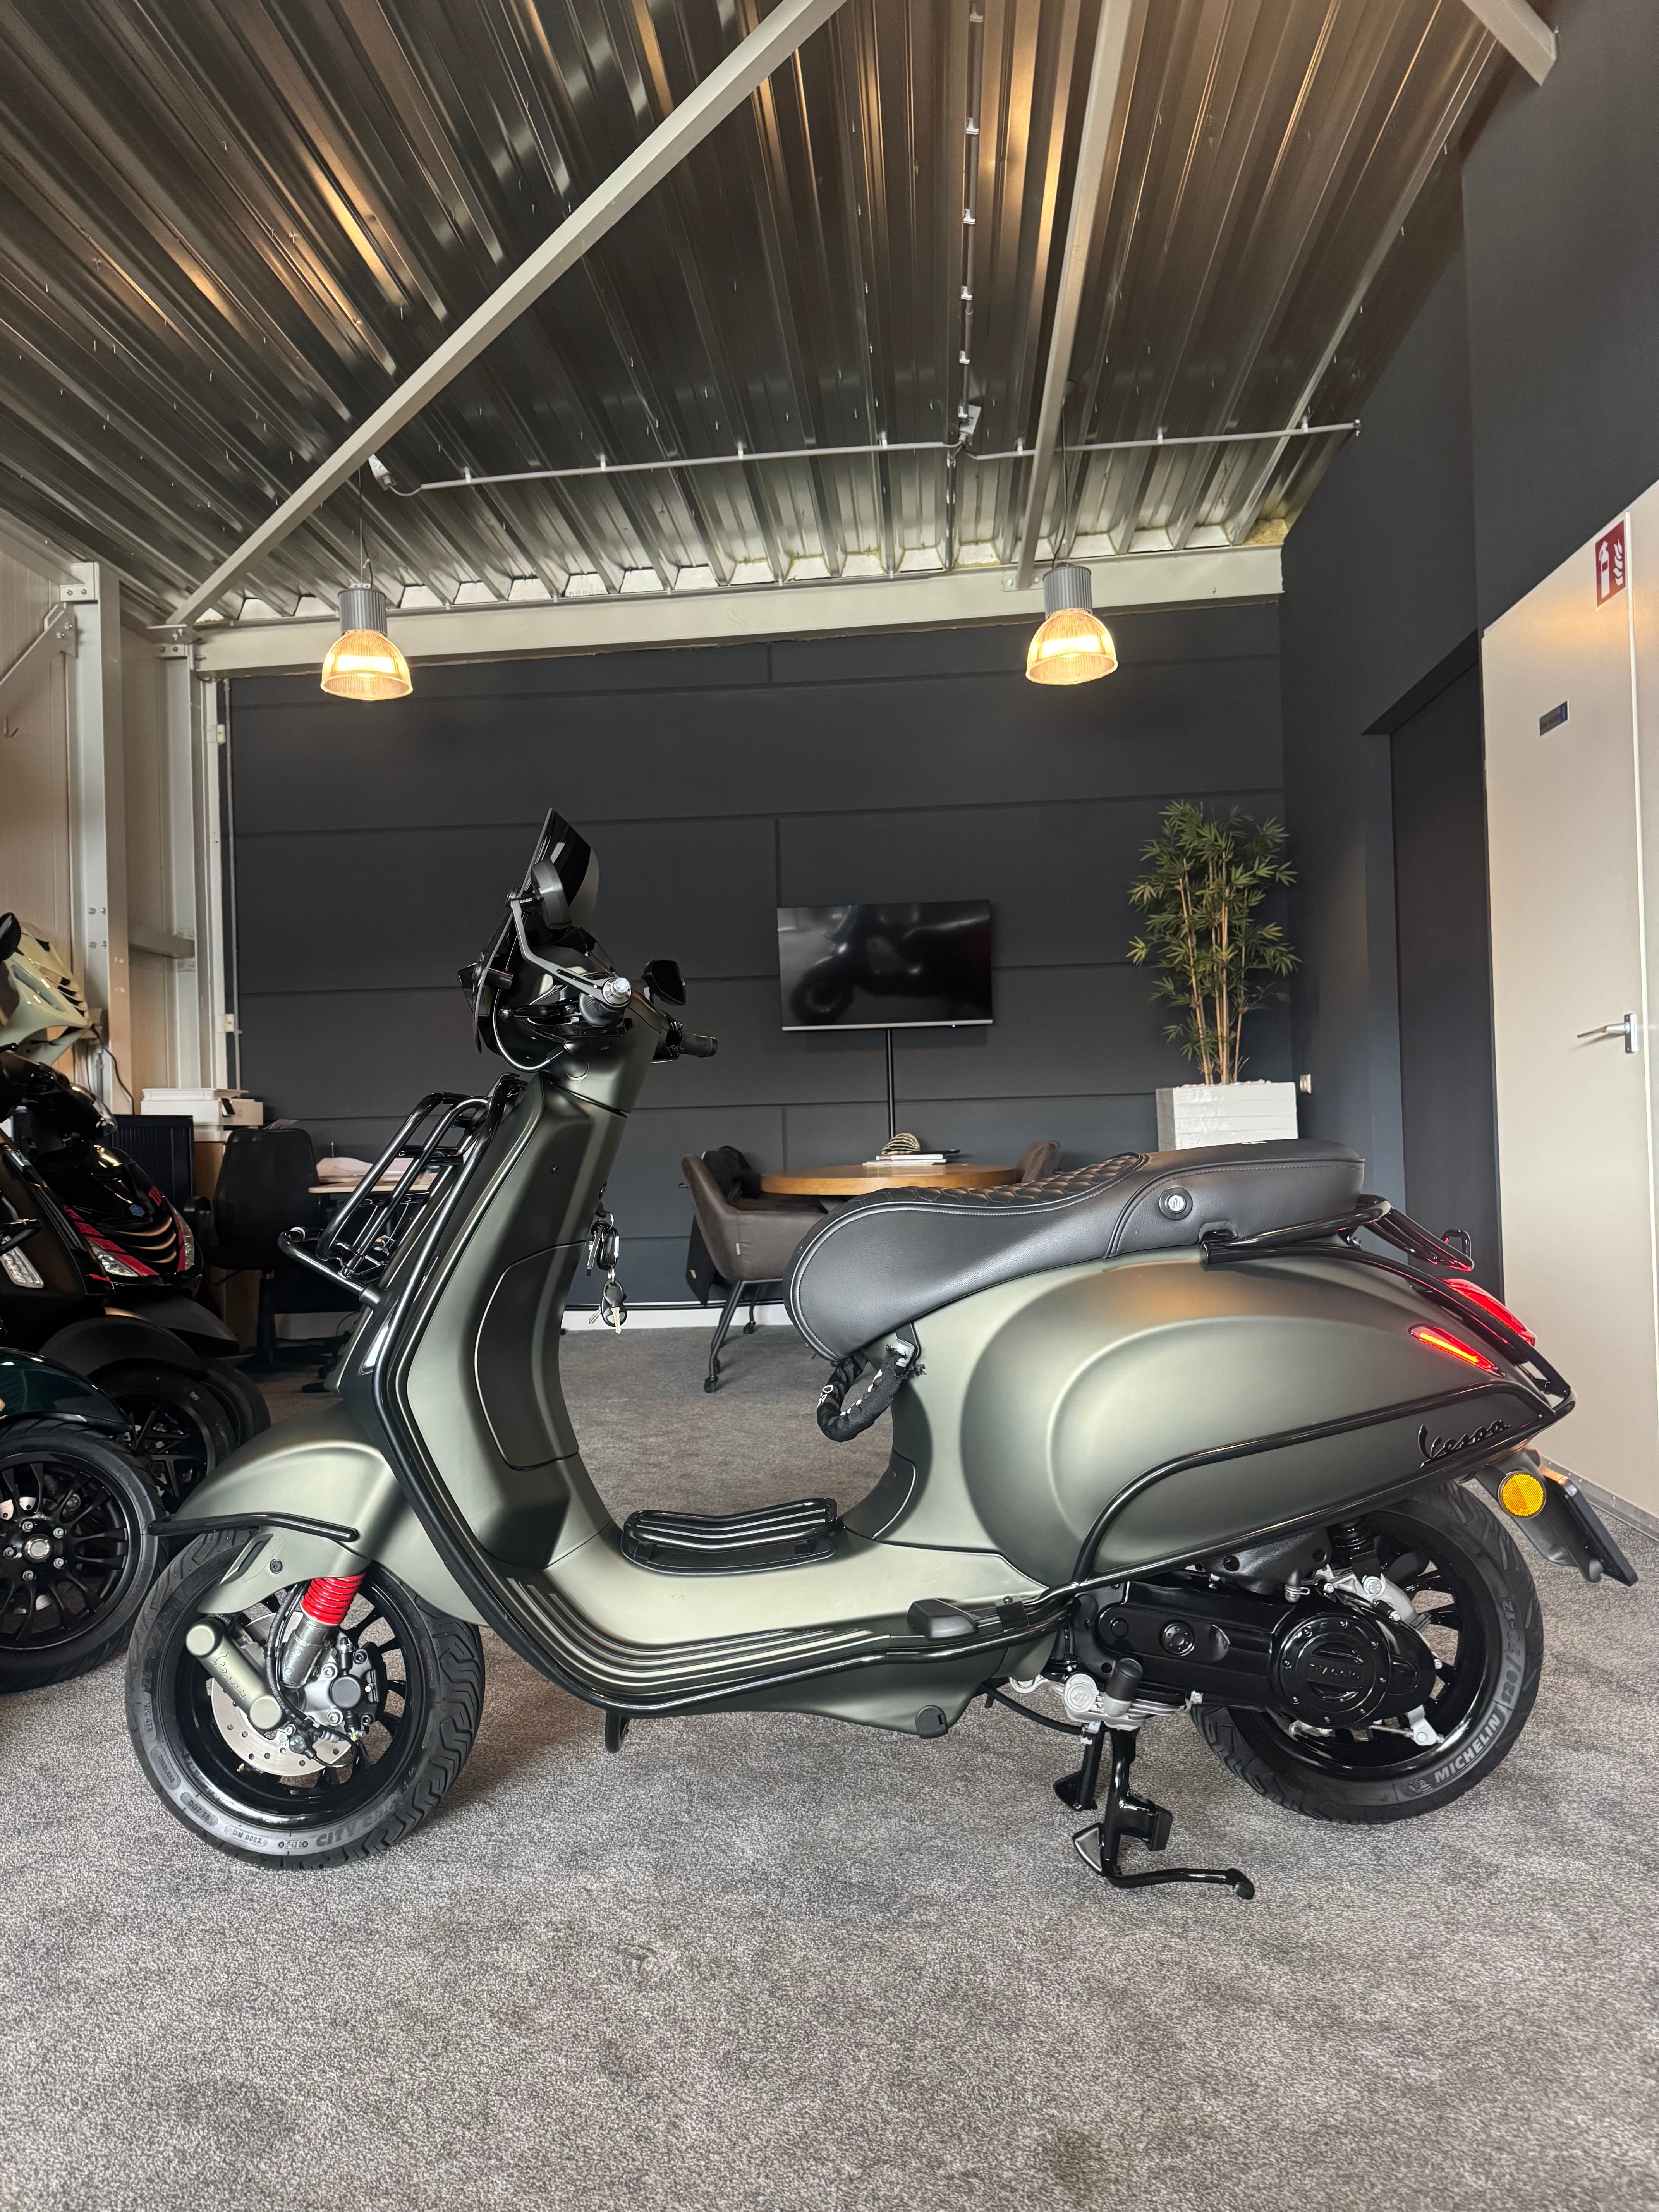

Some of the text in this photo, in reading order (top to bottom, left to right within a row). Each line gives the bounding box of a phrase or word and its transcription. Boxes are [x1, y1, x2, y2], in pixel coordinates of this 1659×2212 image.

[148, 1186, 162, 1206] ZIP
[1418, 1420, 1511, 1468] Vespa
[1501, 1600, 1522, 1704] 120/70-12
[211, 1651, 246, 1702] Vespa
[1434, 1714, 1501, 1783] MICHELIN
[189, 1800, 202, 1814] DOT
[232, 1829, 244, 1838] DM
[316, 1821, 357, 1847] CITY
